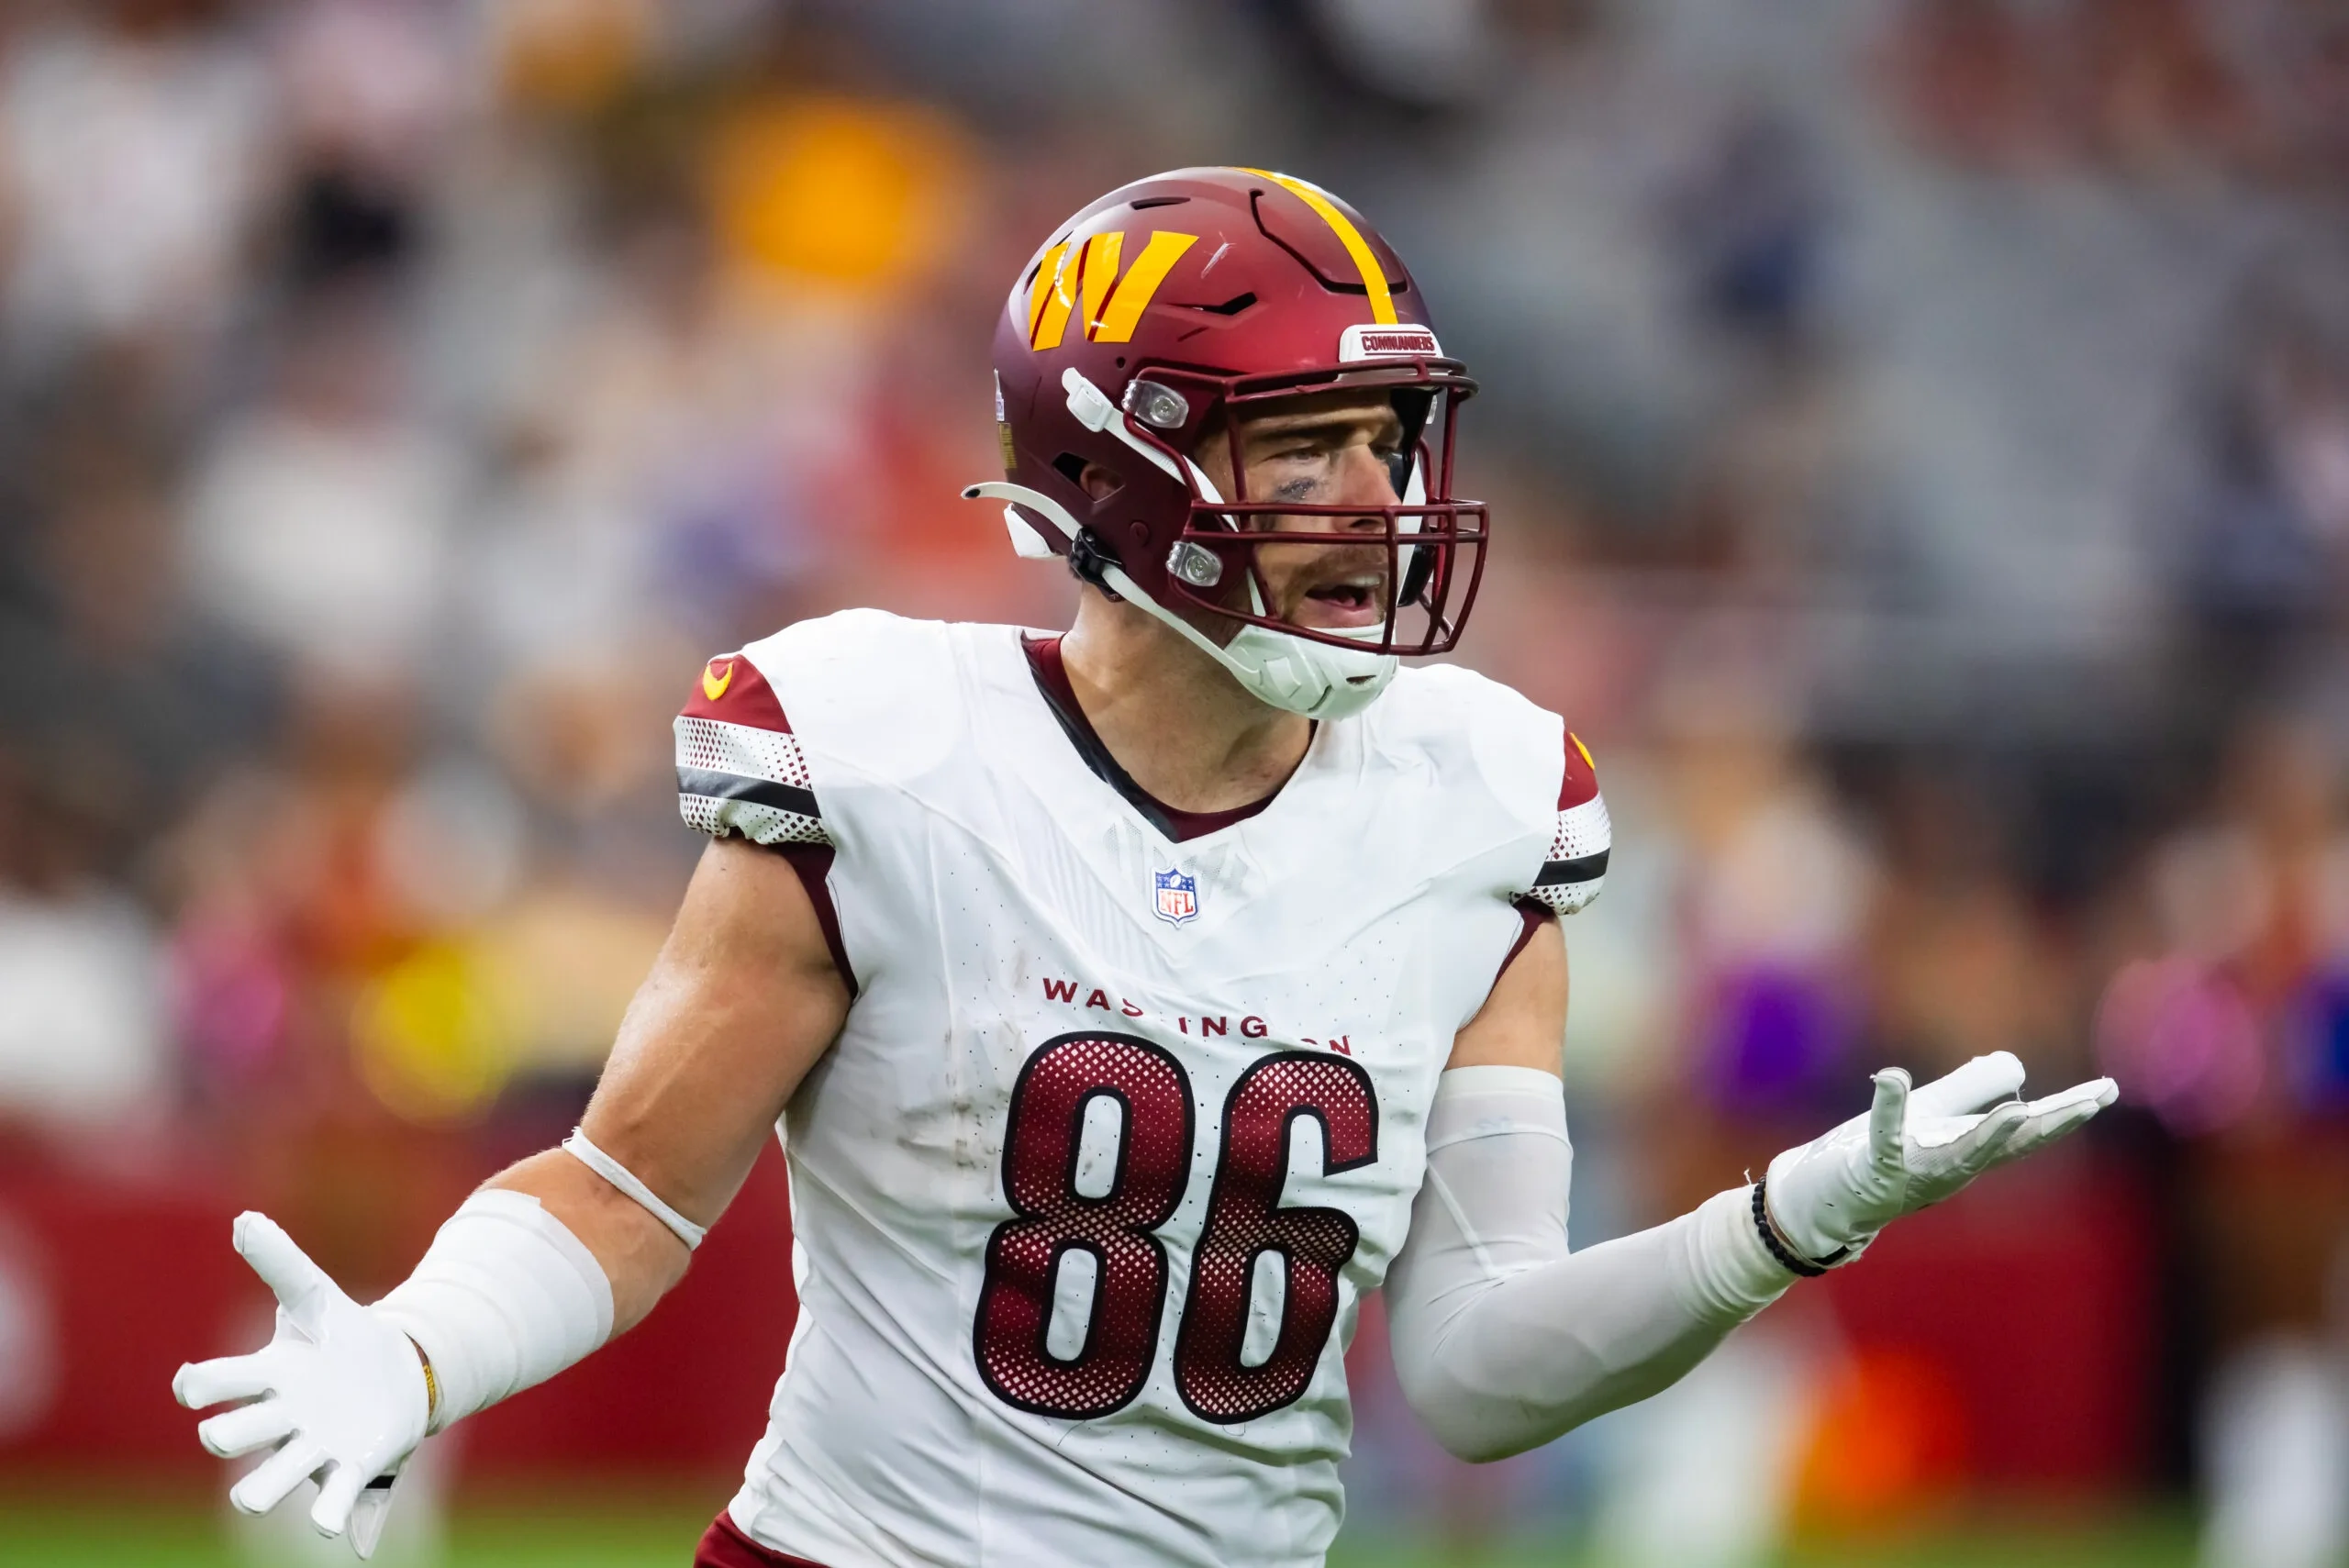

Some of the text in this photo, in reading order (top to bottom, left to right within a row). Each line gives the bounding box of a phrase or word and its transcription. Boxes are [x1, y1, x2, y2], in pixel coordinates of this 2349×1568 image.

[1029, 230, 1199, 351] W
[1361, 335, 1435, 350] COMMANDERS
[1159, 890, 1194, 916] NFL
[1042, 977, 1352, 1056] WASINGN
[973, 1030, 1378, 1425] 86
